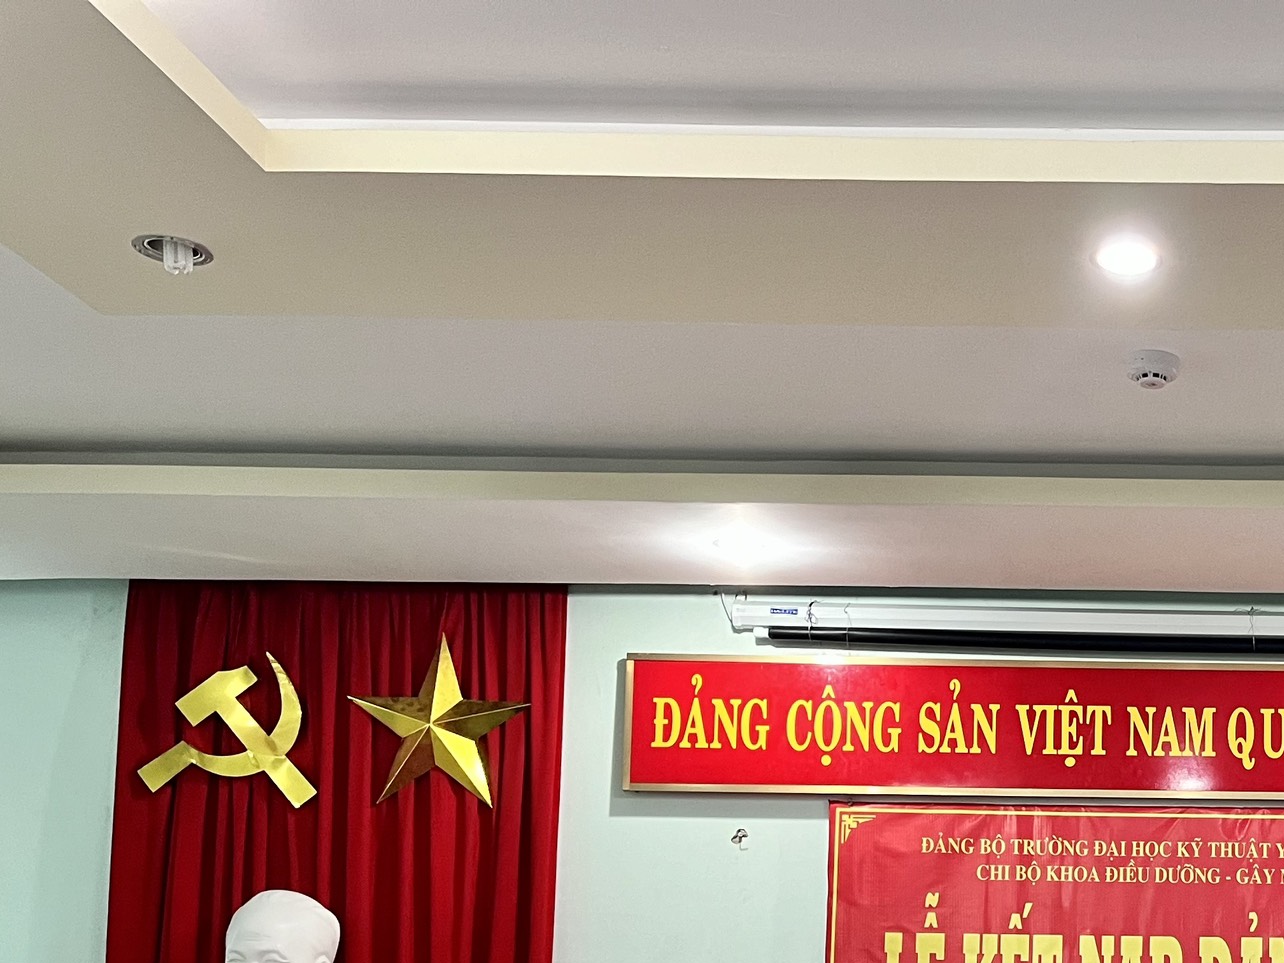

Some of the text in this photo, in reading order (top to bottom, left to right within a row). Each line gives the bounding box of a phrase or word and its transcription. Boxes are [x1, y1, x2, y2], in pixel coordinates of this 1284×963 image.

[652, 673, 769, 751] ĐẢNG
[786, 684, 902, 766] CỘNG
[918, 678, 1000, 755] SẢN
[1015, 689, 1112, 767] VIỆT
[1126, 706, 1217, 759] NAM
[921, 832, 975, 855] ĐẢNG
[980, 833, 1006, 859] BỘ
[1010, 834, 1089, 857] TRƯỜNG
[1094, 839, 1127, 861] ĐẠI
[1131, 840, 1172, 861] HỌC
[1176, 837, 1203, 859] KỸ
[1208, 837, 1272, 862] THUẬT
[976, 864, 1011, 882] CHI
[1015, 860, 1042, 885] BỘ
[1046, 865, 1101, 883] KHOA
[1105, 859, 1150, 884] ĐIỀU
[1154, 863, 1221, 885] DƯỠNG
[1235, 864, 1275, 885] GÂY
